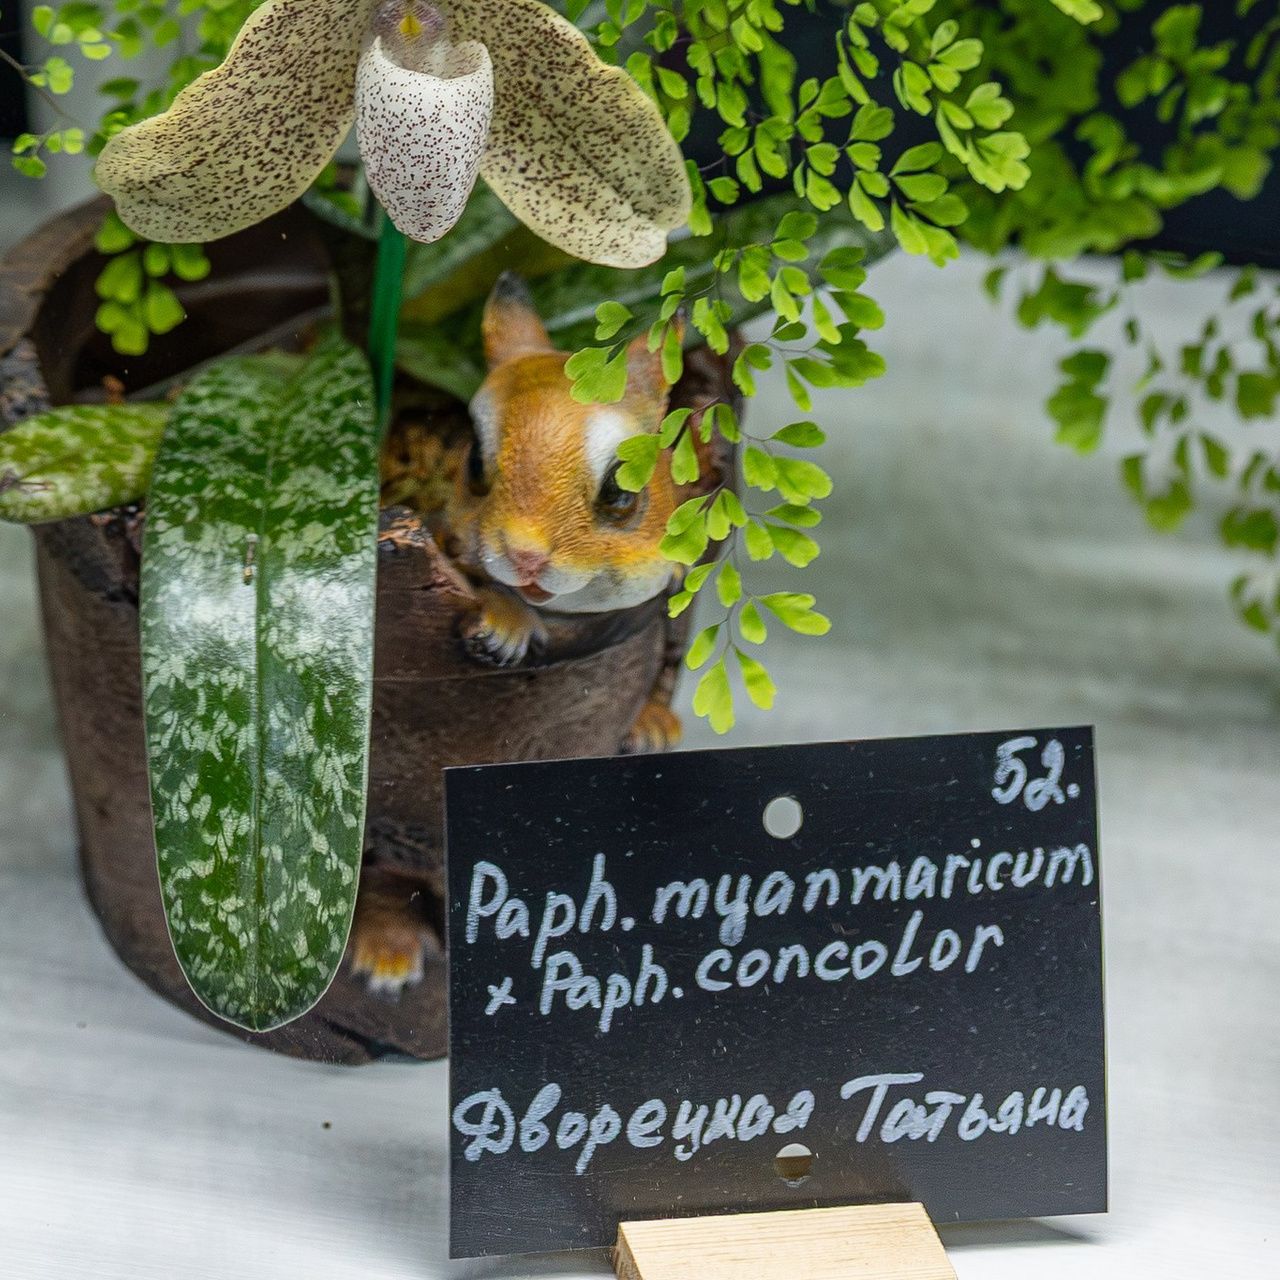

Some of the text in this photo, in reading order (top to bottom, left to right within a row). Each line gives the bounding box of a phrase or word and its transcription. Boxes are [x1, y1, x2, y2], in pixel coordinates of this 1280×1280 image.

[992, 736, 1080, 811] 52.
[465, 837, 1094, 968] Paph. myanmaricum
[539, 943, 685, 1033] Paph.
[695, 910, 1005, 993] concolor
[451, 1073, 1089, 1176] Дворецкая Татьяна
